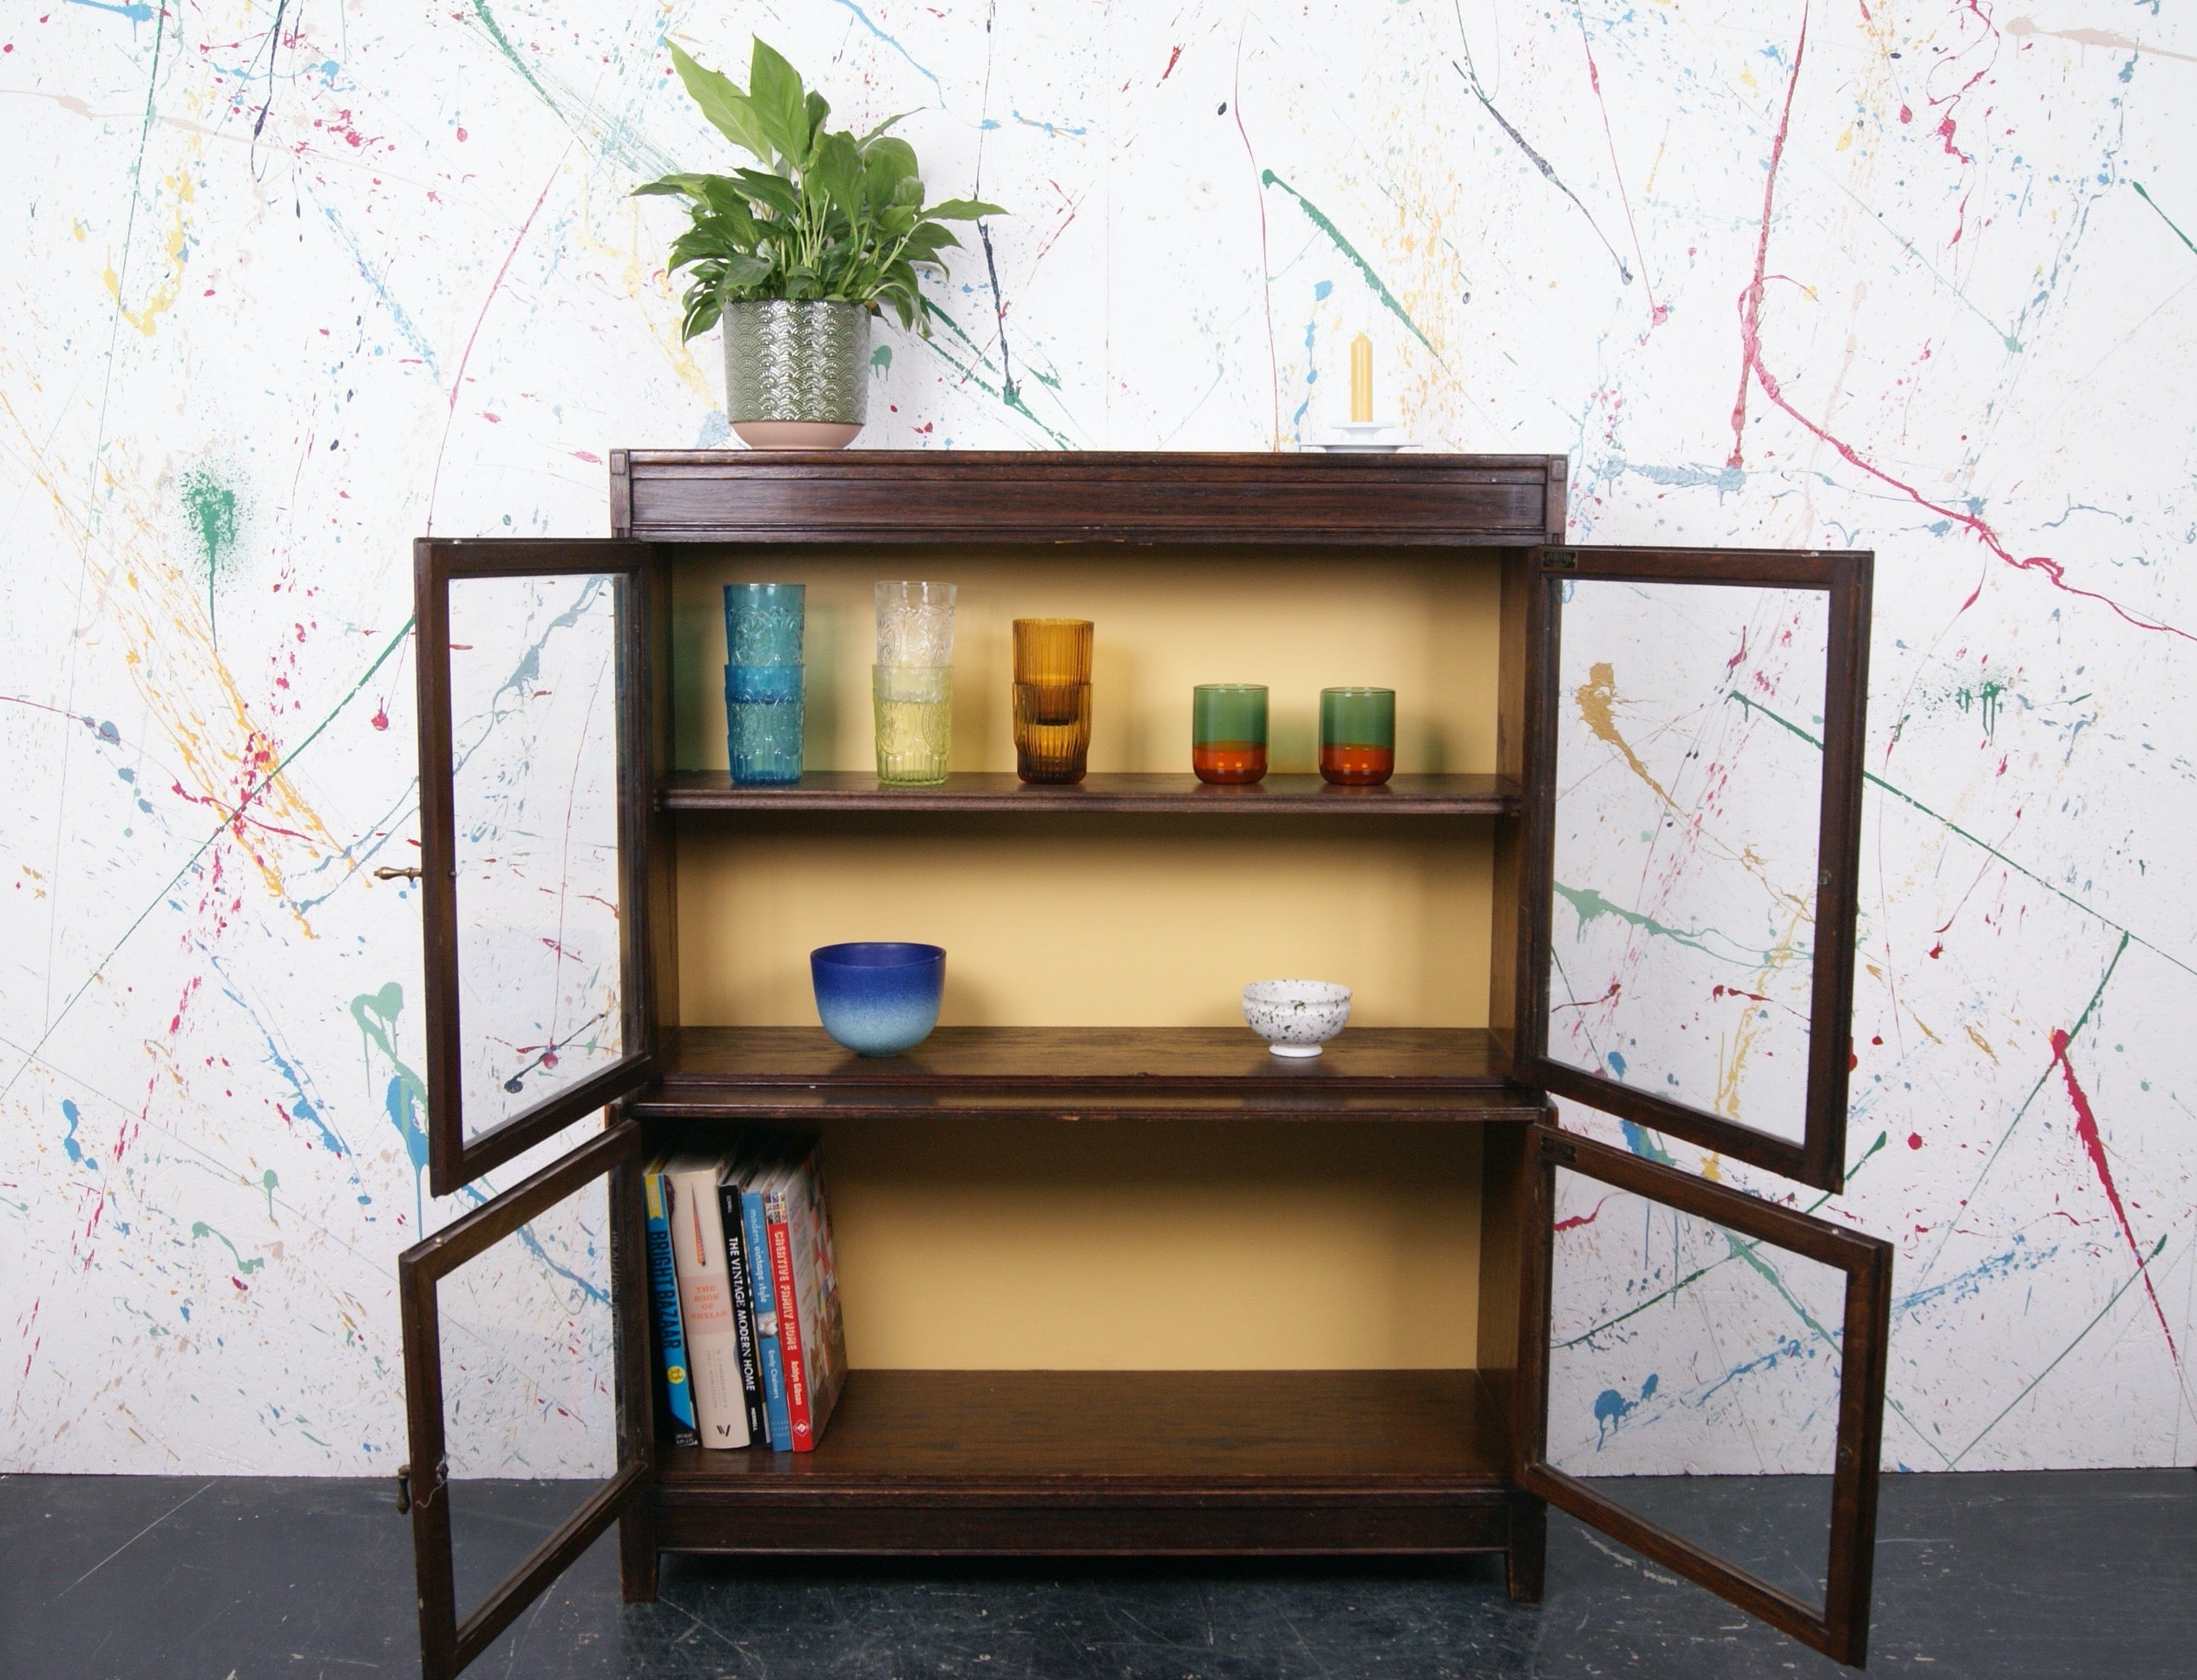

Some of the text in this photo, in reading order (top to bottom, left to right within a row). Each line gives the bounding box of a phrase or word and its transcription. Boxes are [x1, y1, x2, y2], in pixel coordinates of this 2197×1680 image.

[651, 1230, 682, 1349] BRIGHT BAZAAR
[693, 1293, 720, 1302] BOOK
[750, 1209, 771, 1303] modern vintage style
[774, 1230, 797, 1351] CREATIVE FAMILY HOME
[691, 1310, 727, 1320] SHELLS
[729, 1237, 756, 1391] THE VINTAGE MODERN HOME
[791, 1360, 802, 1406] Ashlyn Gibson
